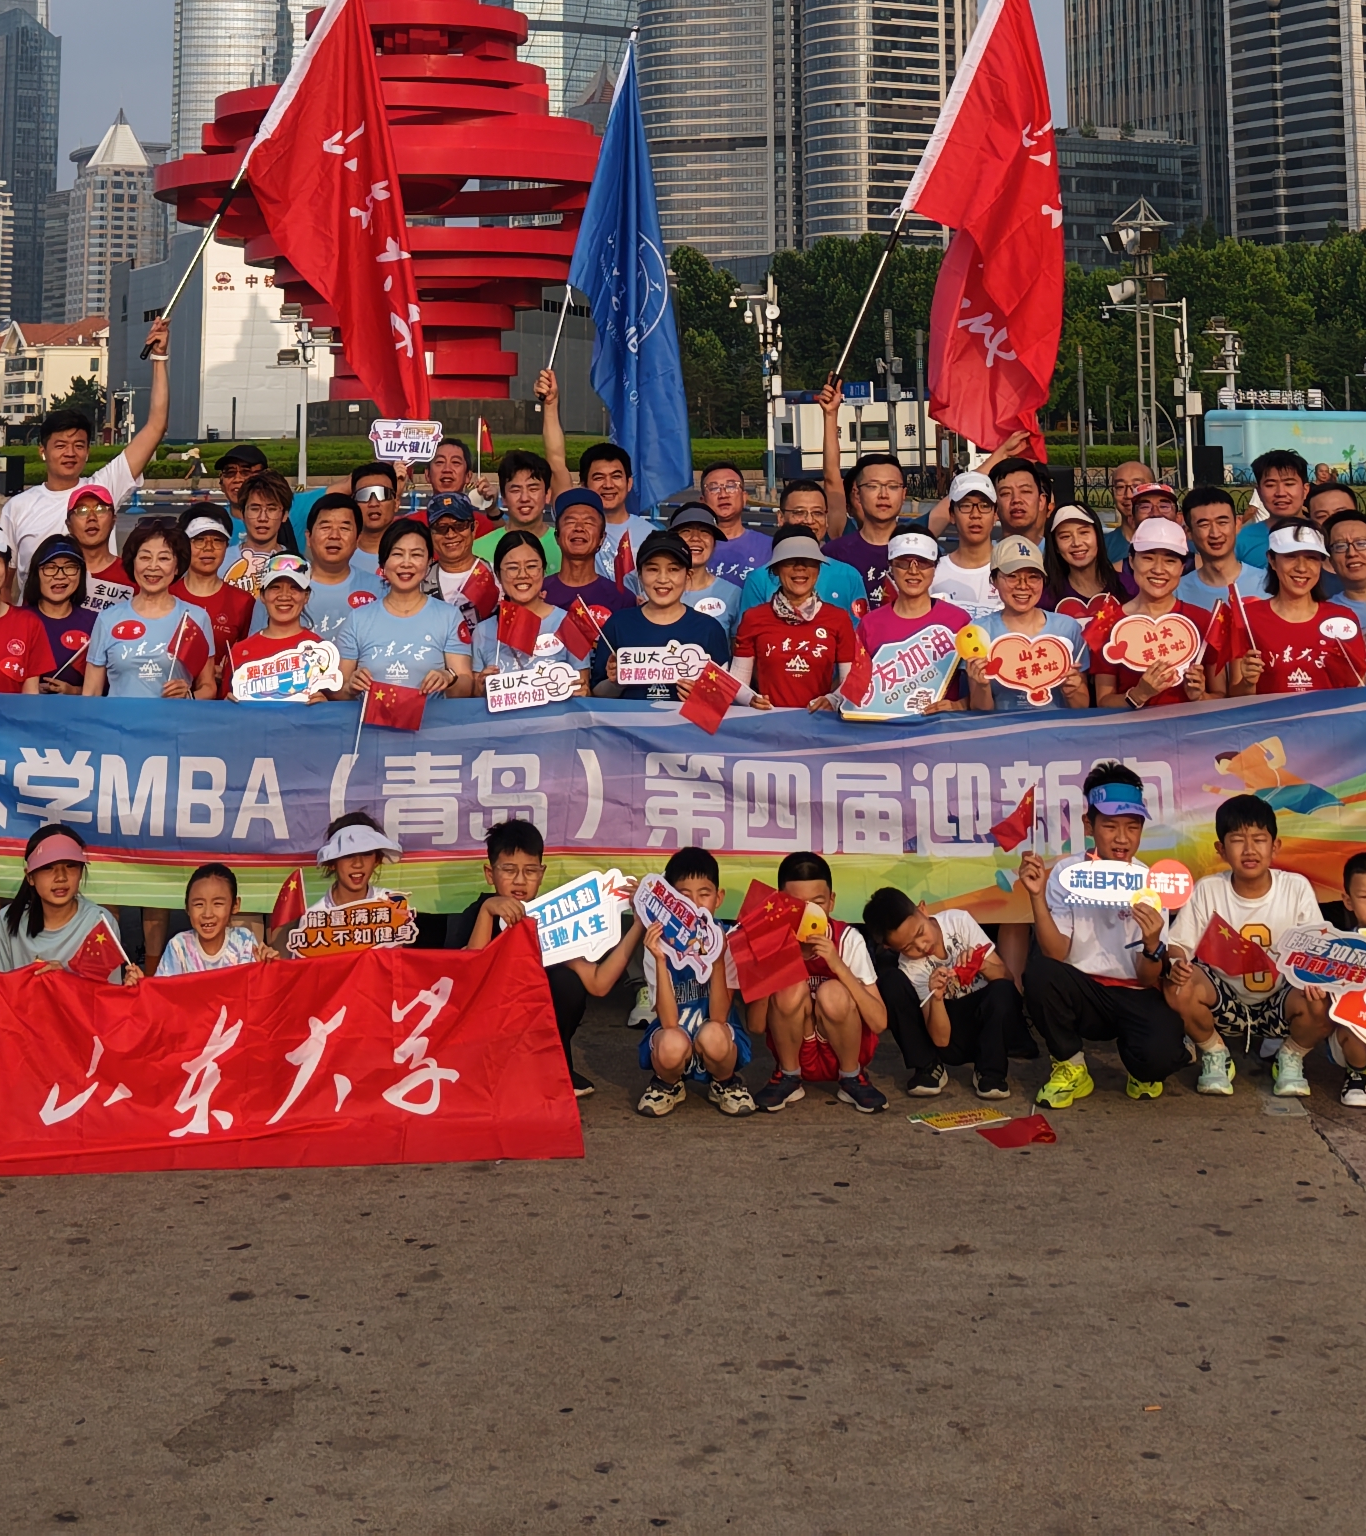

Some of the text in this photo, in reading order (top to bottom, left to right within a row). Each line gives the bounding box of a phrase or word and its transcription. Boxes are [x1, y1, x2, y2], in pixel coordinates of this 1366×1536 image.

[385, 440, 432, 454] 山大健儿
[1017, 542, 1032, 558] LA
[94, 584, 133, 601] 全山大
[1143, 625, 1173, 643] 山大
[619, 650, 661, 665] 全山大
[1018, 646, 1048, 662] 山大
[1141, 642, 1188, 663] 我来啦
[619, 666, 675, 682] 醉靓的妞
[1015, 660, 1060, 680] 我来啦
[488, 672, 530, 690] 全山大
[489, 687, 546, 709] 醉靓的妞
[1148, 871, 1190, 895] 流汗
[306, 909, 391, 928] 能量满满
[290, 923, 416, 949] 见人不如健身
